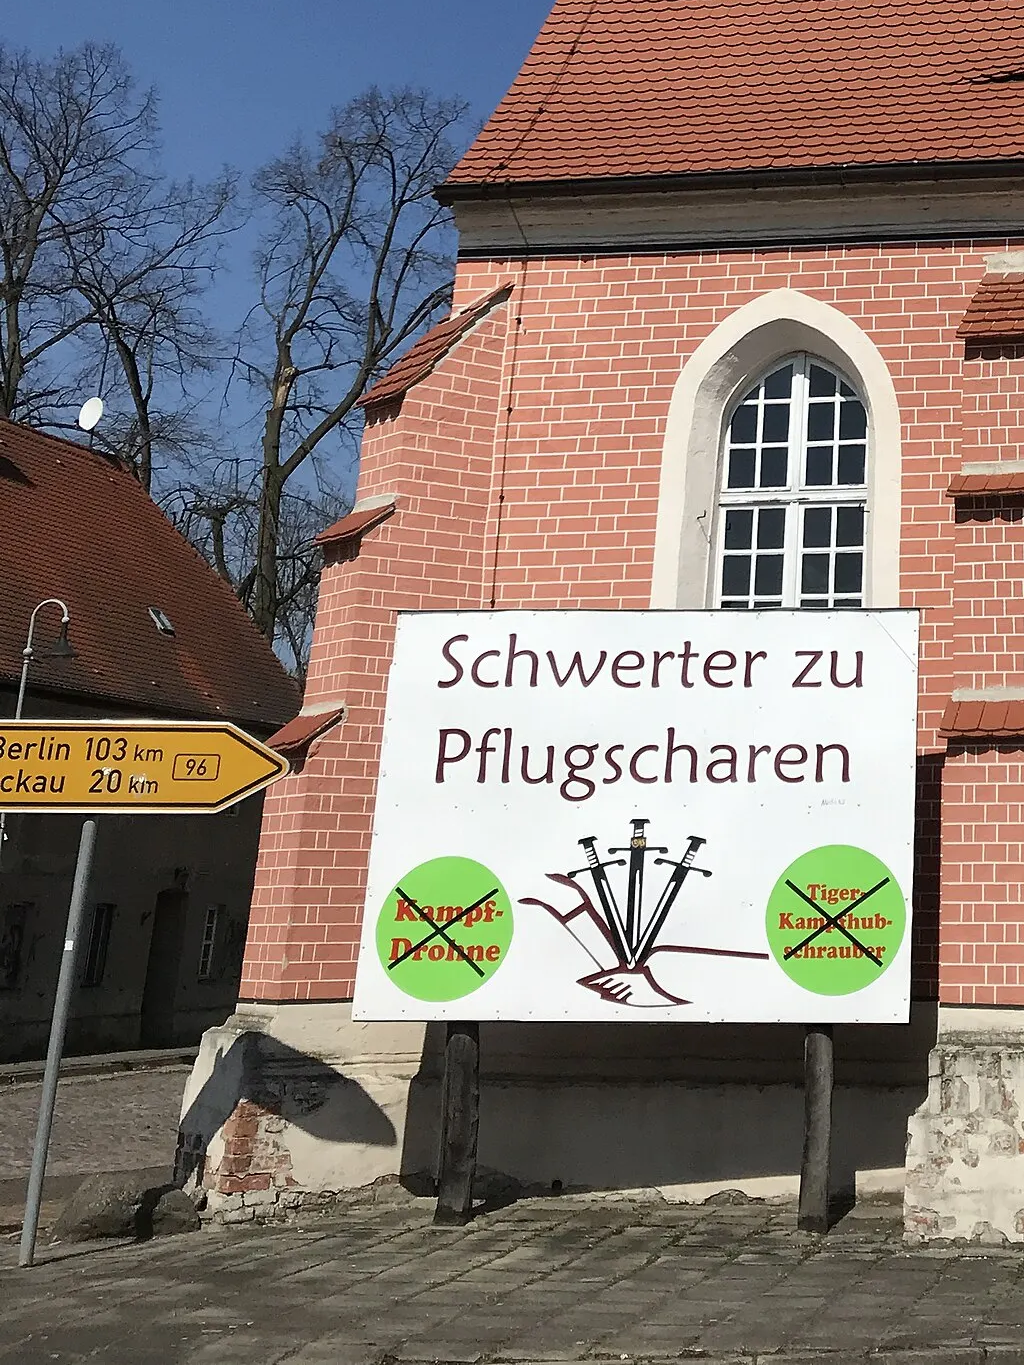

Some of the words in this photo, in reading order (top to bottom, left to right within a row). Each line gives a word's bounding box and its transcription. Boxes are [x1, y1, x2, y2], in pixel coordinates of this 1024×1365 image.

[437, 633, 768, 689] Schwerter
[791, 650, 864, 689] zu
[85, 737, 128, 762] 103
[132, 744, 164, 763] km
[185, 758, 208, 776] 96
[434, 726, 852, 803] Pflugscharen
[88, 768, 123, 794] 20
[127, 774, 160, 794] km
[393, 898, 504, 928] Kampf-
[778, 912, 893, 933] Kamhub-
[388, 937, 501, 962] Drohne
